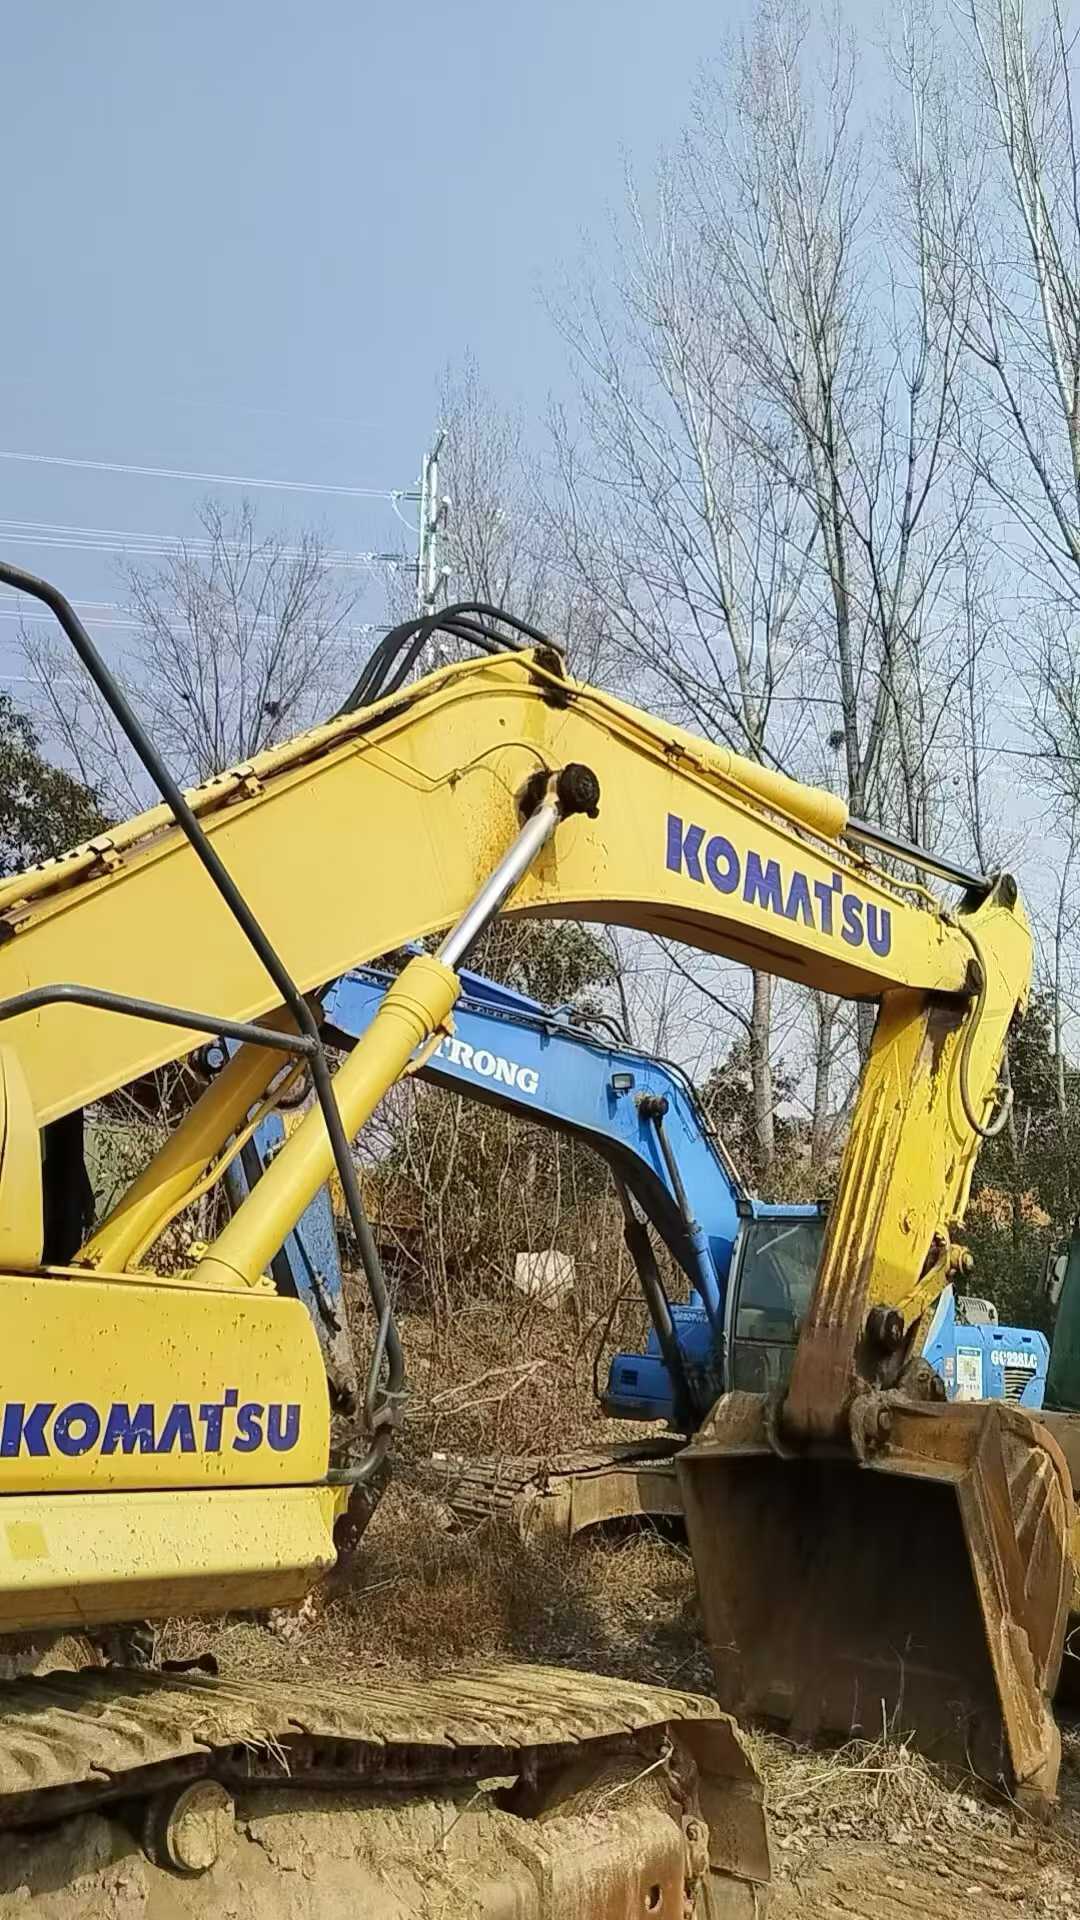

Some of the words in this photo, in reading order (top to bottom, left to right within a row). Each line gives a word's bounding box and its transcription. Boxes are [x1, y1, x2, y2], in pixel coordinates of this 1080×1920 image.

[666, 812, 892, 958] KOMATSU
[419, 1034, 540, 1094] TRONG
[0, 1389, 301, 1457] KOMATSU
